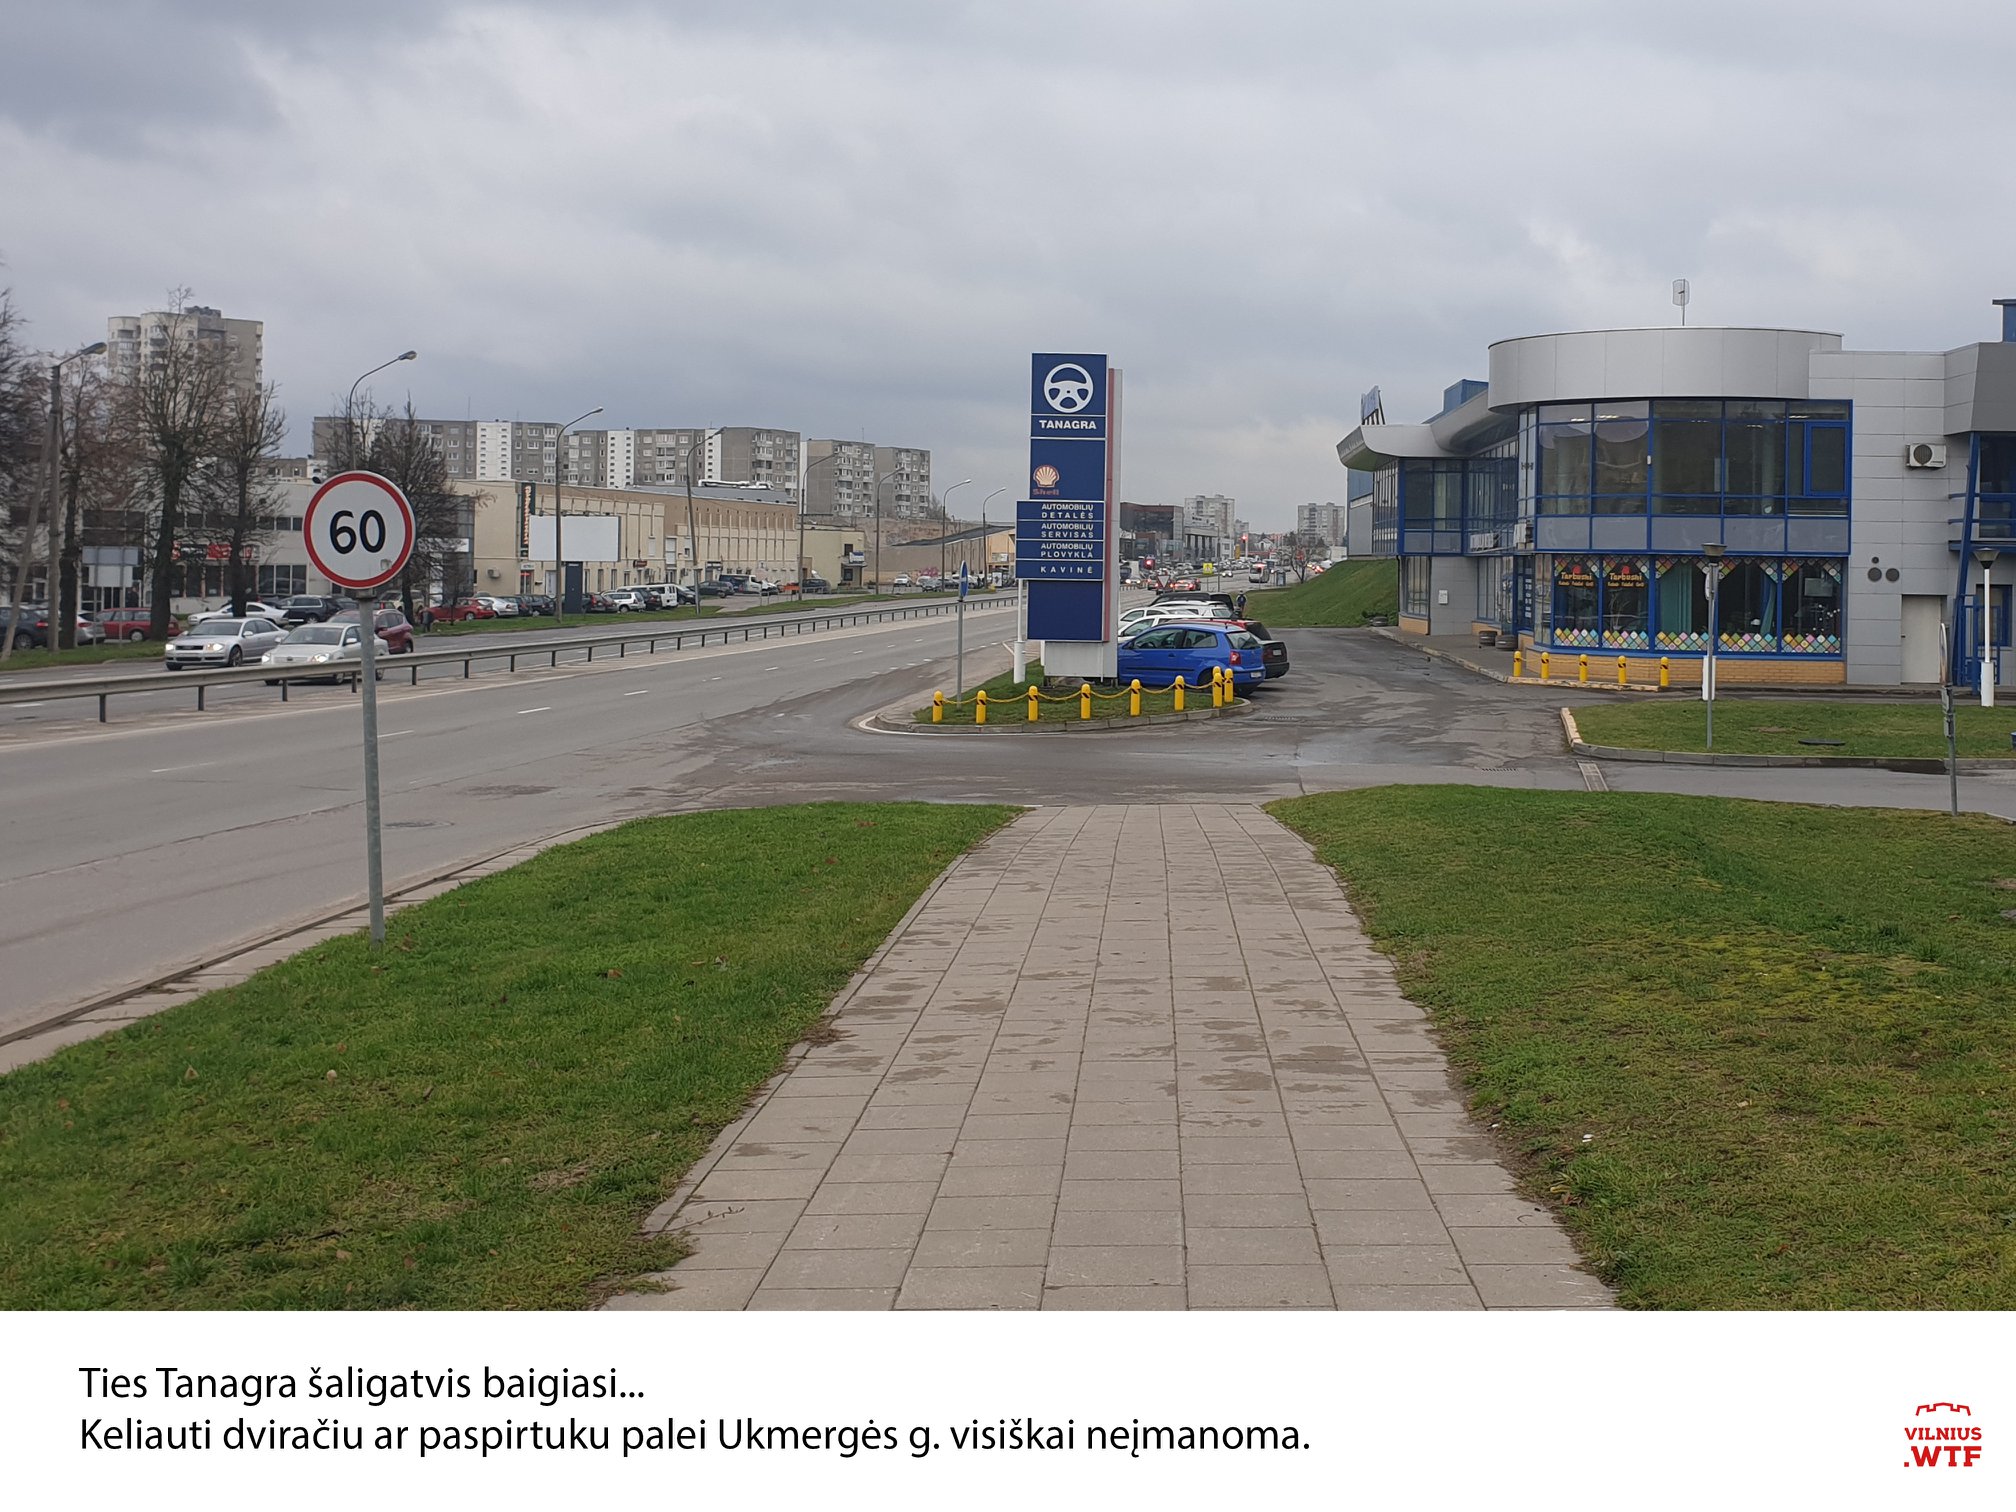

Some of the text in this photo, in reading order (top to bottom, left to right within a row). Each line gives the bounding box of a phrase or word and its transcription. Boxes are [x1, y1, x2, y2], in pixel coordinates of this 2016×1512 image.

[1039, 420, 1097, 429] TANAGRA
[1041, 503, 1094, 511] AUTOMOBILIŲ
[1041, 523, 1094, 531] AUTOMOBILIŲ
[329, 509, 386, 555] 60
[1040, 543, 1093, 551] AUTOMOBILIŲ
[1040, 566, 1093, 574] KAVINĖ
